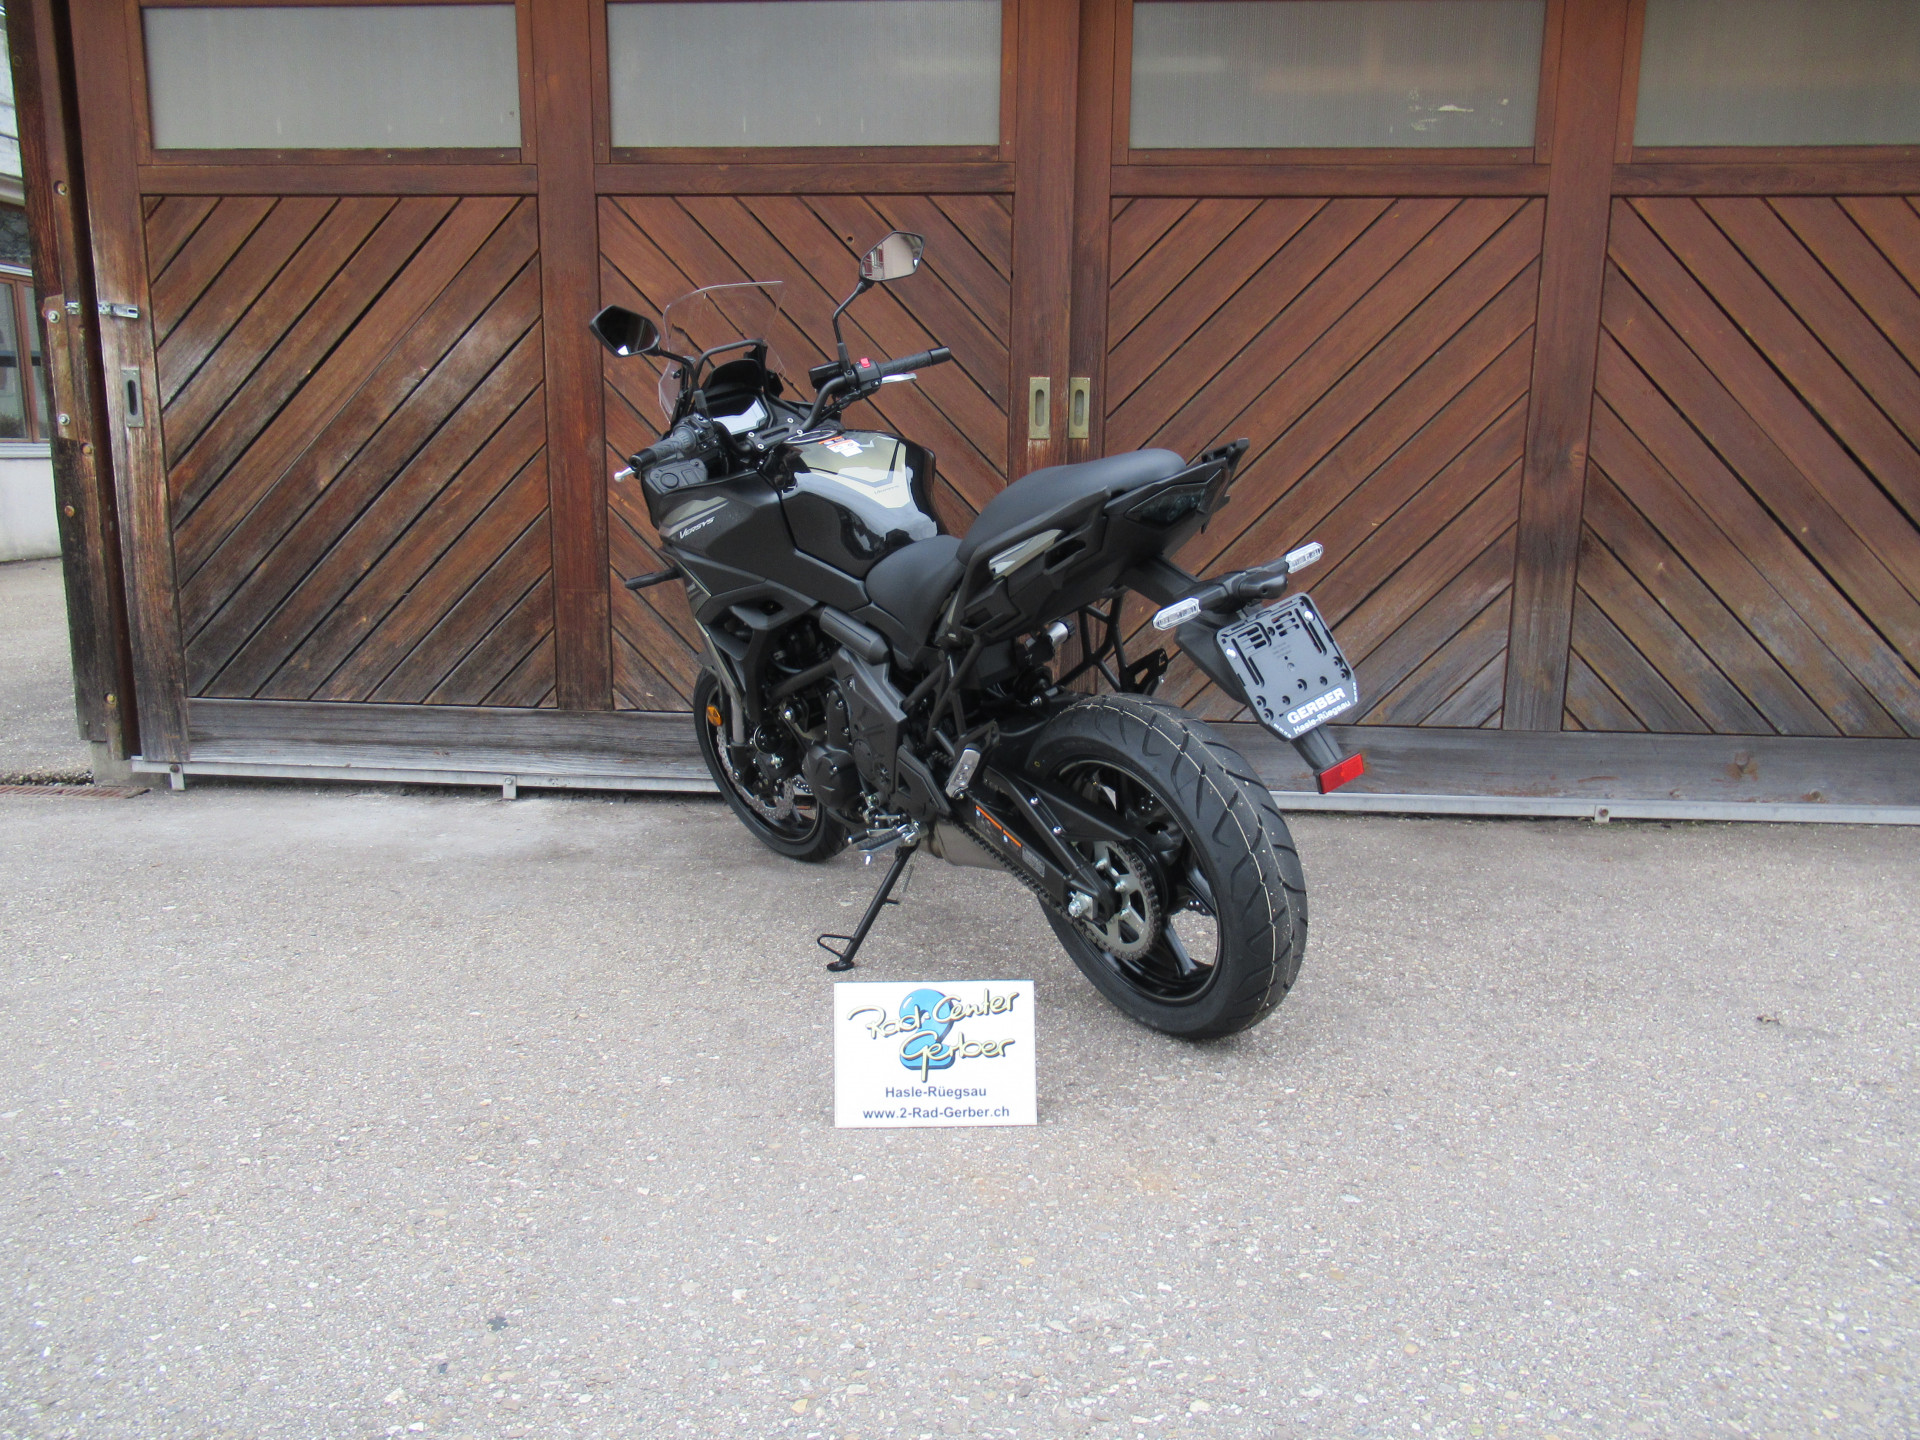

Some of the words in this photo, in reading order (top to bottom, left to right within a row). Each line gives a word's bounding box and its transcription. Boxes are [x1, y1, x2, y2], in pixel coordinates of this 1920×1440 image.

[1287, 687, 1345, 723] GERBER
[900, 1030, 1015, 1083] Gerber
[885, 1086, 986, 1099] Hasle-Rüegsau
[863, 1106, 1009, 1118] www.2-Rad-Gerber.ch
